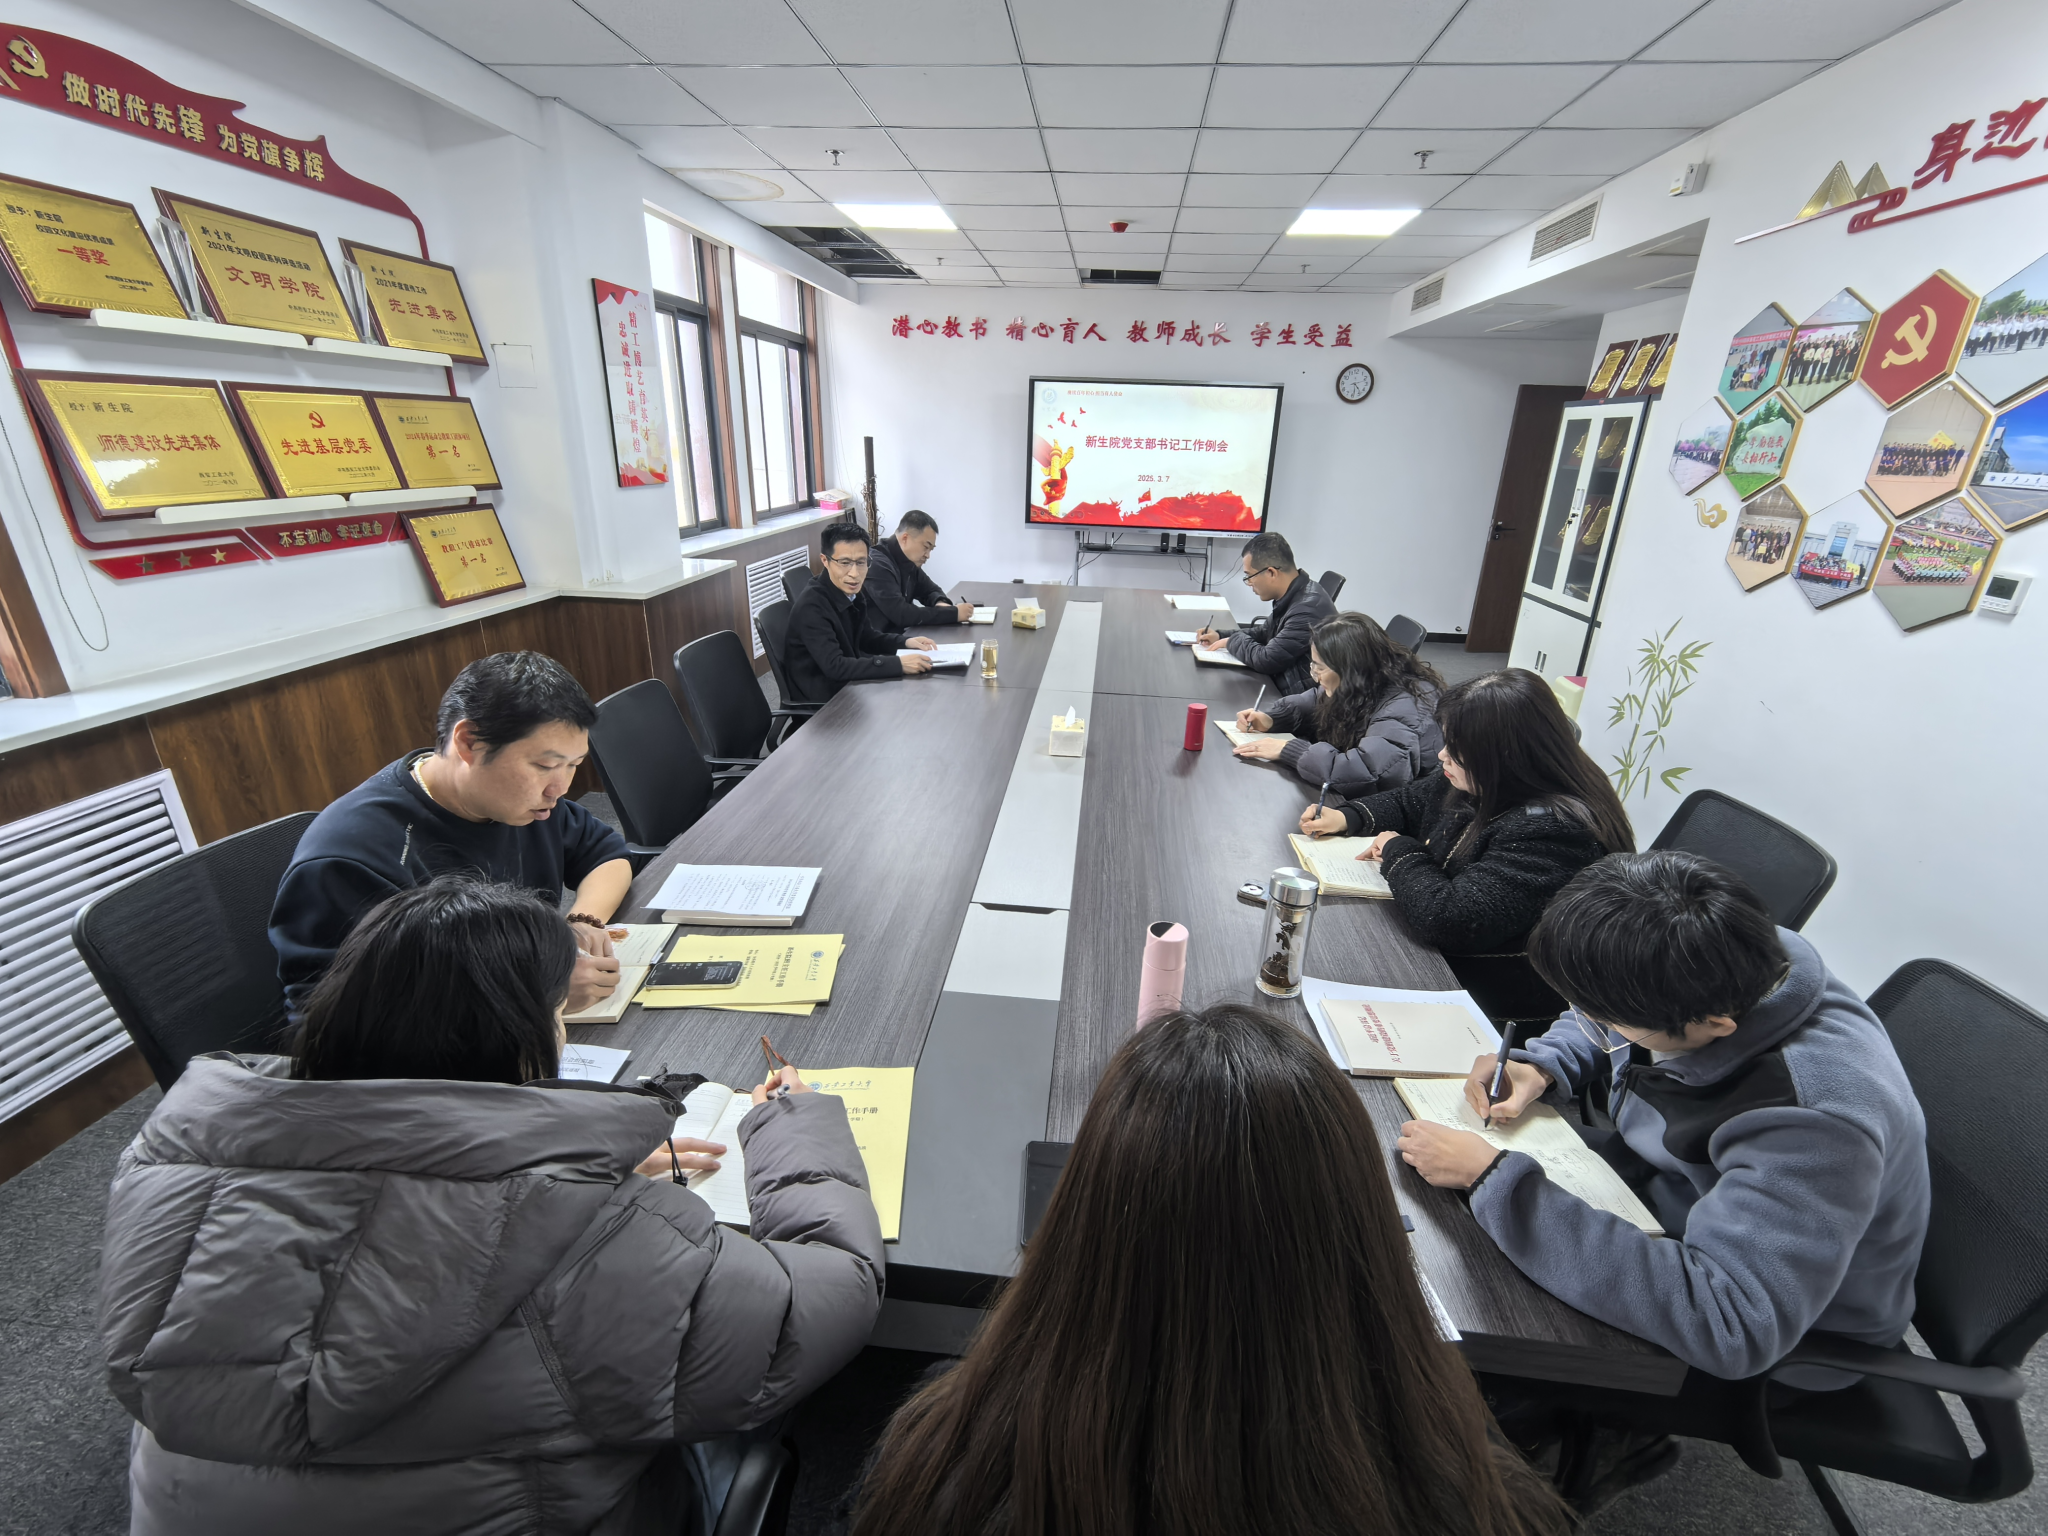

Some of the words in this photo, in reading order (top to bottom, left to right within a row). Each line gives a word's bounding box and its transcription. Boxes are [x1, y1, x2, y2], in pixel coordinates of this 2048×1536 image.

[62, 71, 206, 142] 做时代先锋
[217, 123, 325, 182] 为党旗争辉
[1911, 97, 2048, 190] 身边
[201, 226, 236, 244] 新生院
[57, 245, 110, 267] 一等奖
[206, 240, 311, 272] 2021年文明校园系列评选活动
[225, 265, 325, 301] 文明学院
[375, 277, 428, 295] 2021年度宣传工作
[388, 297, 458, 323] 先进集体
[891, 315, 988, 341] 潜心教书
[1006, 315, 1107, 344] 精心育人
[1126, 319, 1231, 347] 教师成长
[1249, 320, 1354, 348] 学生受益
[96, 433, 222, 453] 师德建设先进集体
[281, 437, 373, 456] 先进基层党委
[426, 444, 461, 460] 第一名
[1085, 435, 1229, 453] 新生院党支部书记工作例会
[279, 527, 333, 548] 不忘初心
[336, 520, 383, 541] 牢记使命
